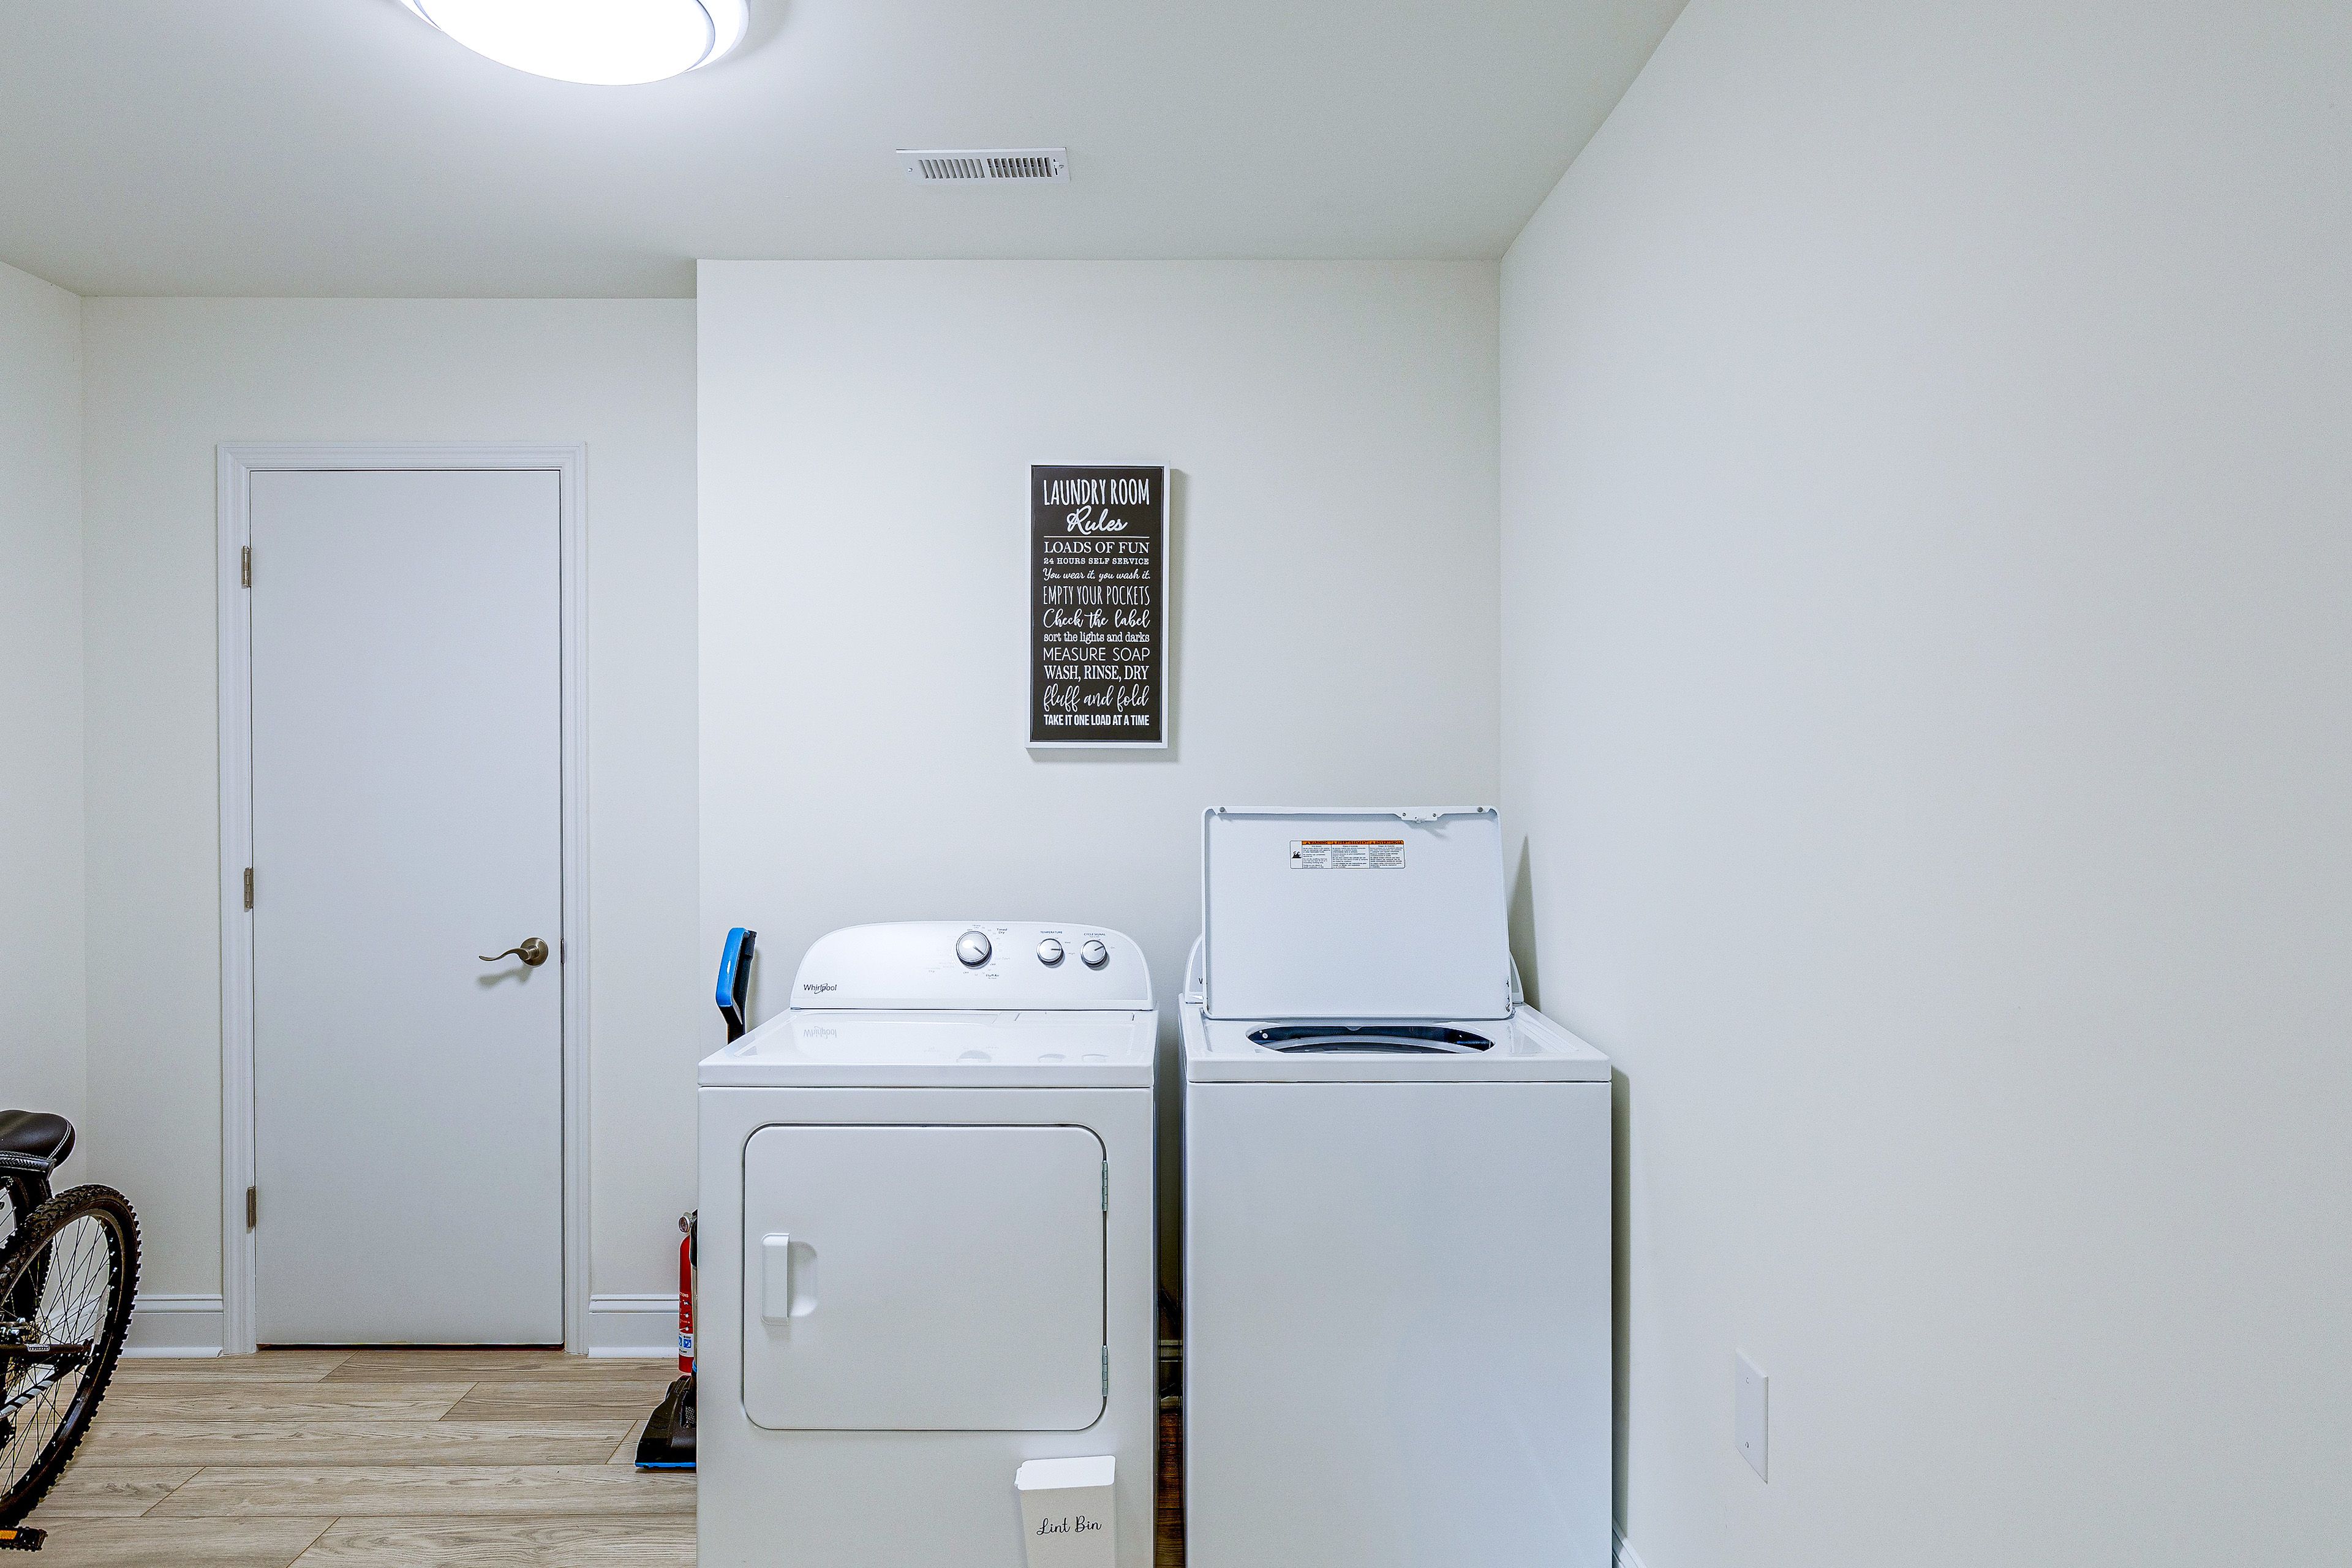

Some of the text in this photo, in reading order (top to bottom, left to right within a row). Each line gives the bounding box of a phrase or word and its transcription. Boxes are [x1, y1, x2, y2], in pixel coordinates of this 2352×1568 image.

[1044, 478, 1150, 506] LAUNDRY ROOM
[1066, 505, 1128, 536] Rules
[1044, 541, 1150, 554] LOADS OF FUN
[1042, 567, 1061, 581] You
[1098, 573, 1115, 582] you
[1116, 568, 1140, 579] wash
[1043, 586, 1150, 606] EMPTY YOUR POCKETS
[1042, 608, 1151, 628] Check the label
[1043, 631, 1150, 645] sort the lights and darks
[1043, 647, 1150, 662] MEASURE SOAP
[1044, 665, 1150, 682] WASH, RINSE, DRY
[1043, 683, 1150, 712] fluff and fold
[1044, 714, 1150, 726] TAKE IT ONE LOAD AT A TIME
[803, 983, 837, 994] Whirlpool
[1036, 1515, 1102, 1536] Lint Bin
